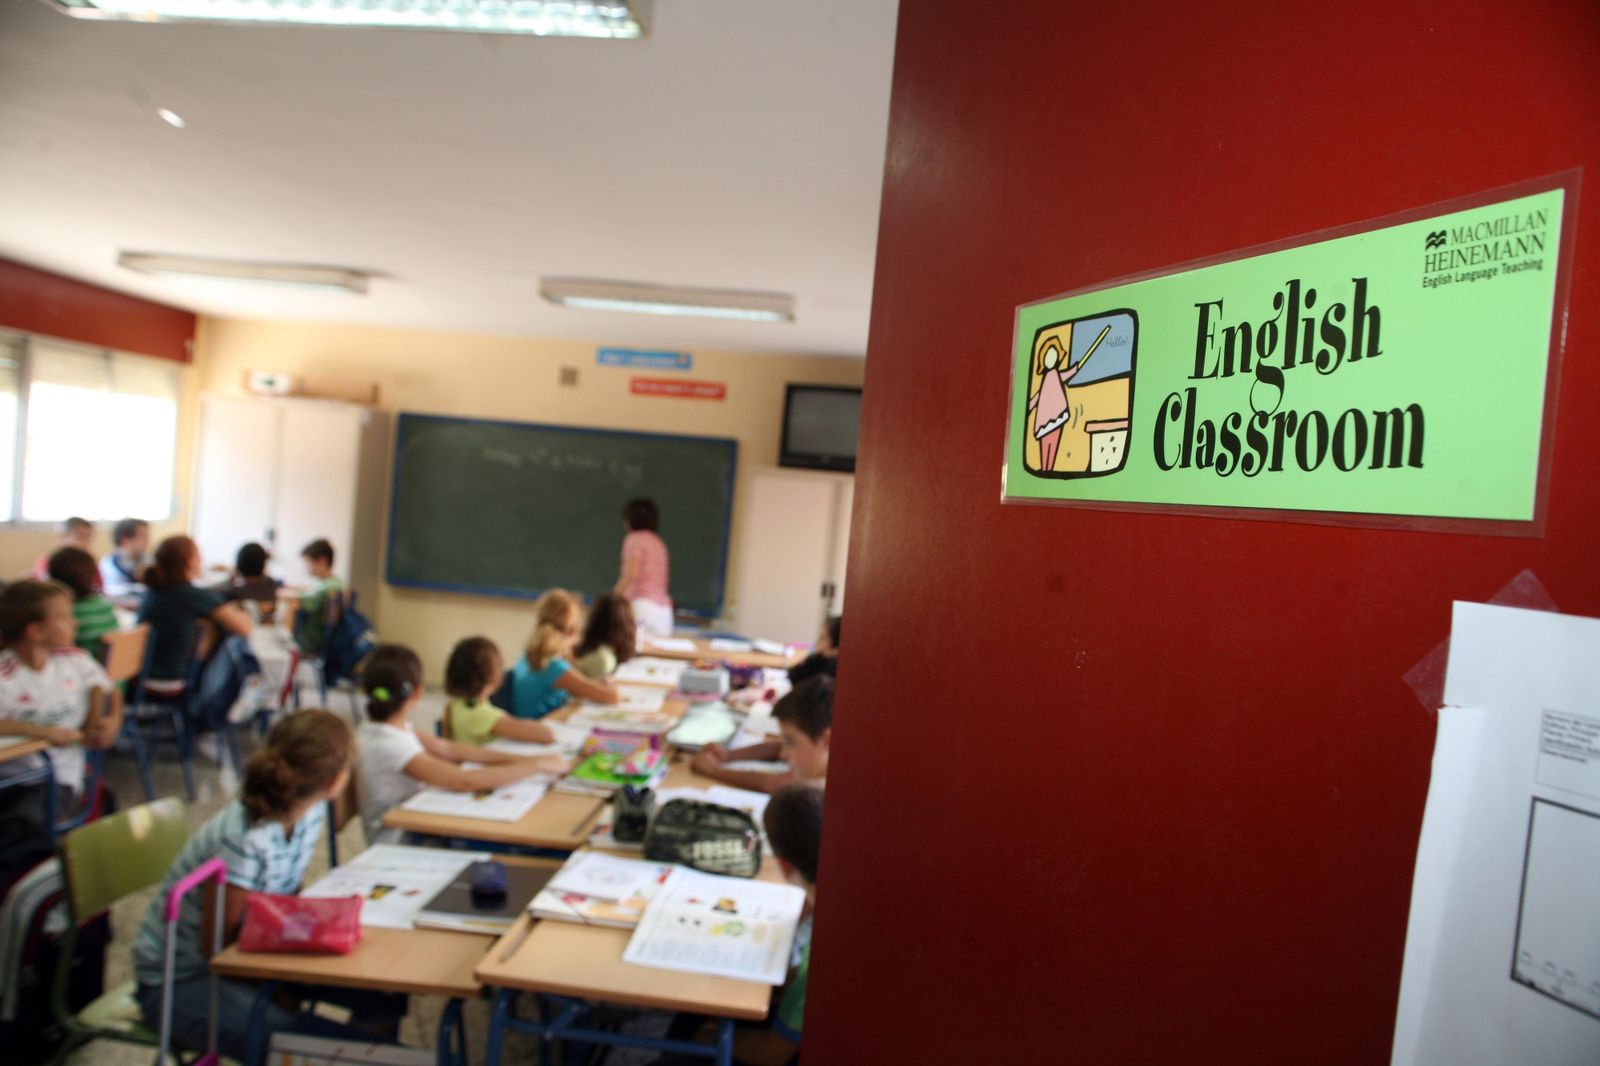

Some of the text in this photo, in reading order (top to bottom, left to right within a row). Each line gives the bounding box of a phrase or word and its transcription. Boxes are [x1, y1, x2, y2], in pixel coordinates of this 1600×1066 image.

[1451, 209, 1548, 245] MACMILLAN
[1424, 232, 1545, 273] HEINEMANN
[1422, 258, 1543, 288] English Language Teaching
[1105, 335, 1129, 348] Hello!
[1188, 277, 1383, 416] English
[1153, 387, 1425, 477] Classroom
